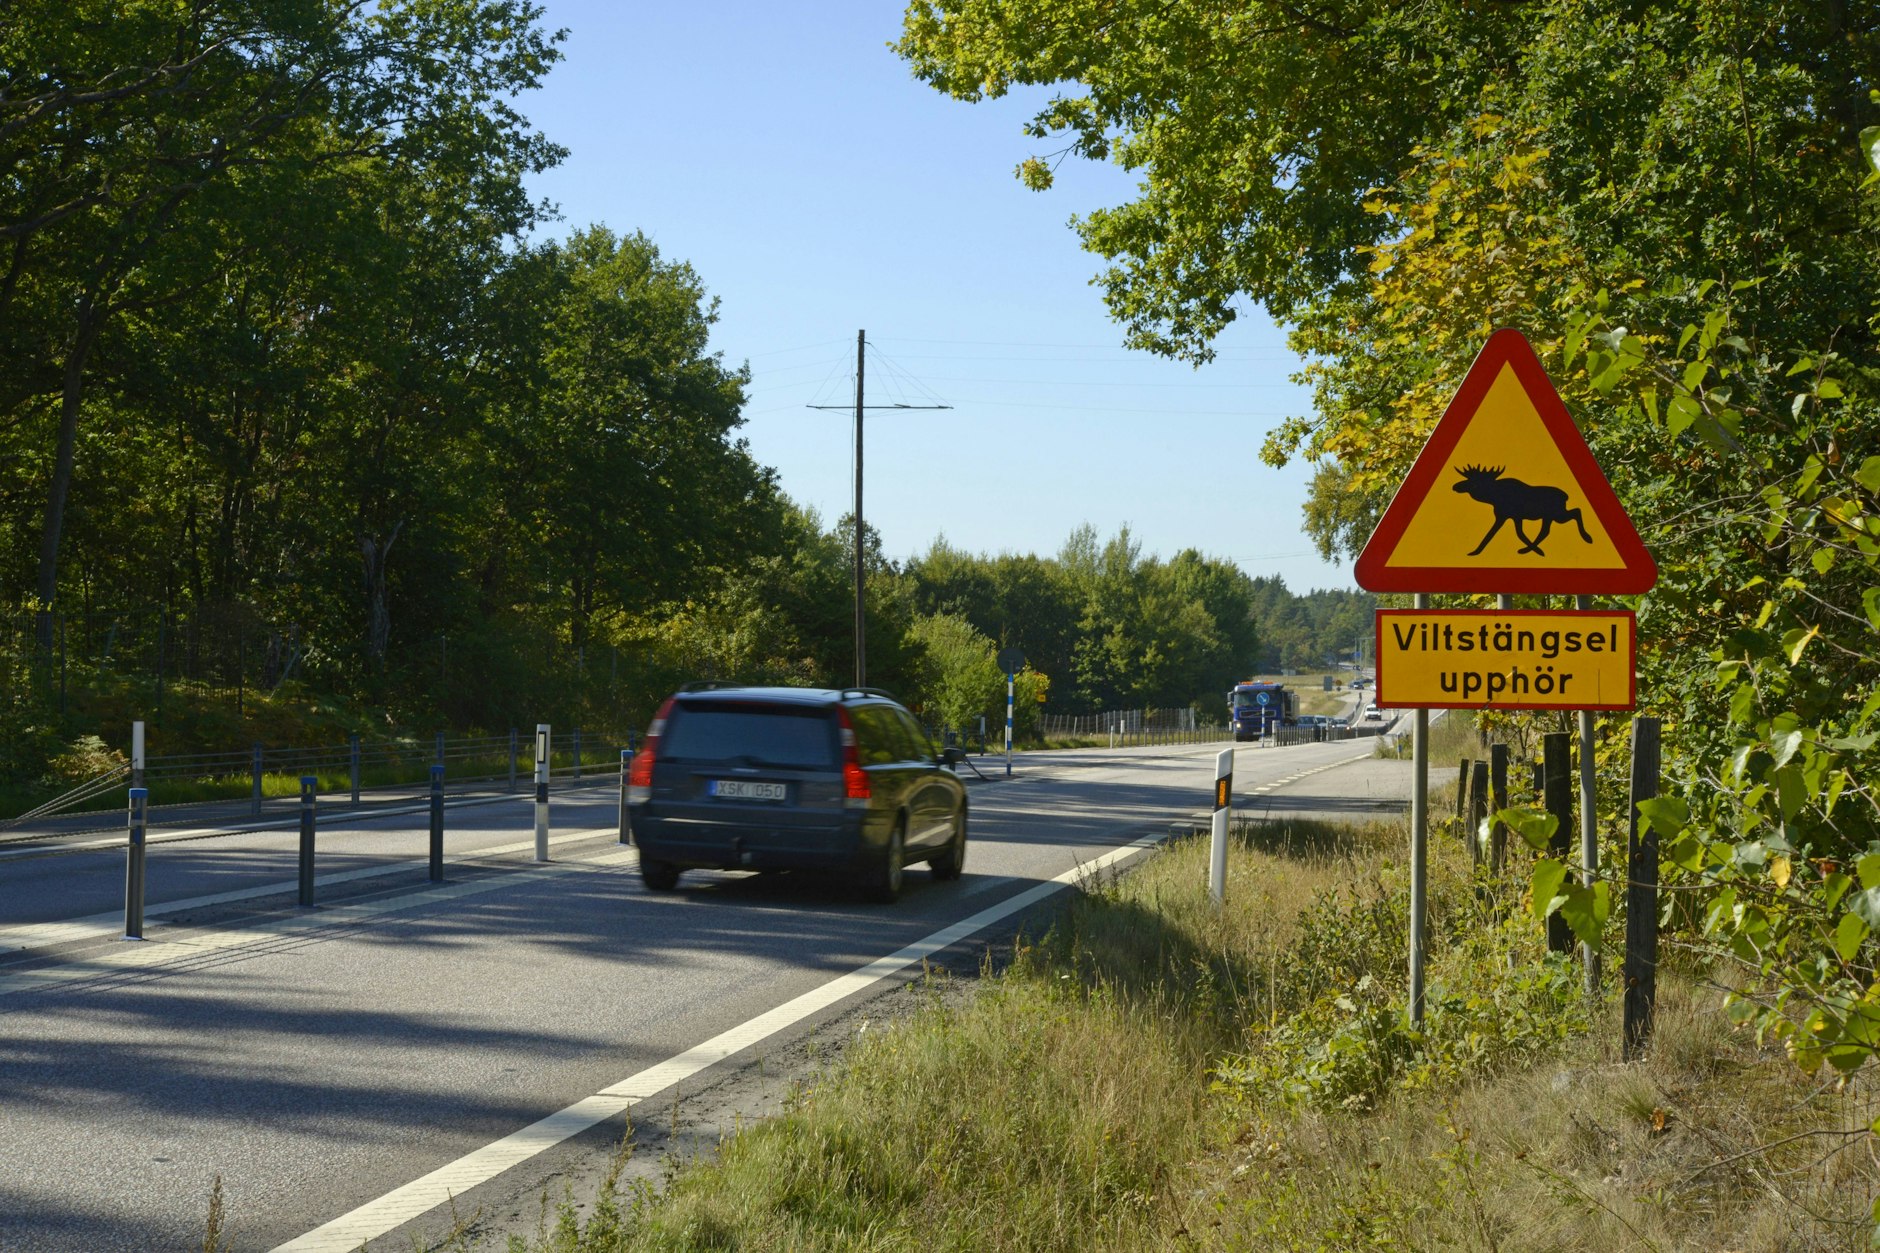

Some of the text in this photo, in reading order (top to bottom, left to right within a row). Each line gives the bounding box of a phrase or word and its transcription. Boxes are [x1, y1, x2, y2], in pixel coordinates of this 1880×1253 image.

[1393, 623, 1616, 659] Viltstängsel
[1440, 665, 1573, 700] upphör
[719, 783, 783, 798] XSK 050
